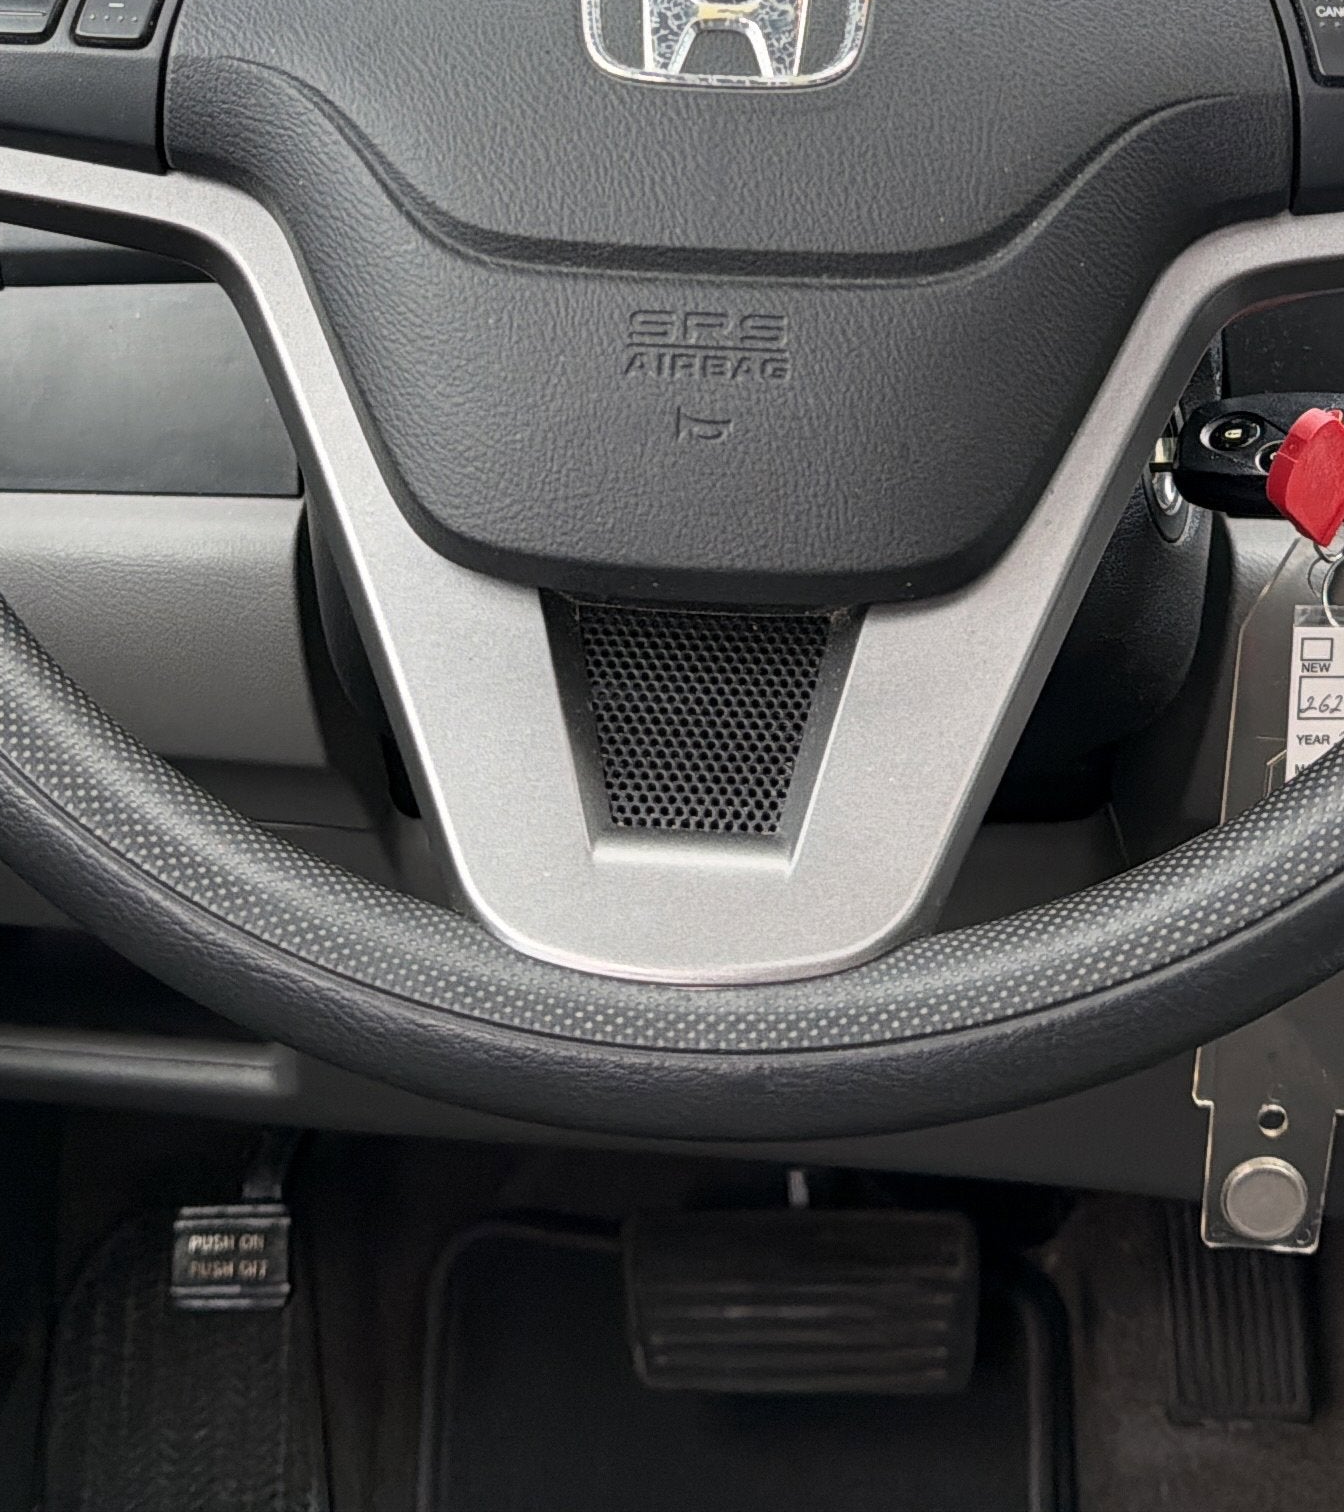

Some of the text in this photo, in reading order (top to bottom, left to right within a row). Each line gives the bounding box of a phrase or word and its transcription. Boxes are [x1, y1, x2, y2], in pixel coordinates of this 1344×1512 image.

[627, 309, 789, 343] SRS
[624, 352, 792, 380] AIRBAG
[1301, 663, 1331, 673] NEW
[1296, 734, 1331, 746] YEAR
[188, 1234, 265, 1252] PUSH ON
[191, 1260, 234, 1278] PUSH
